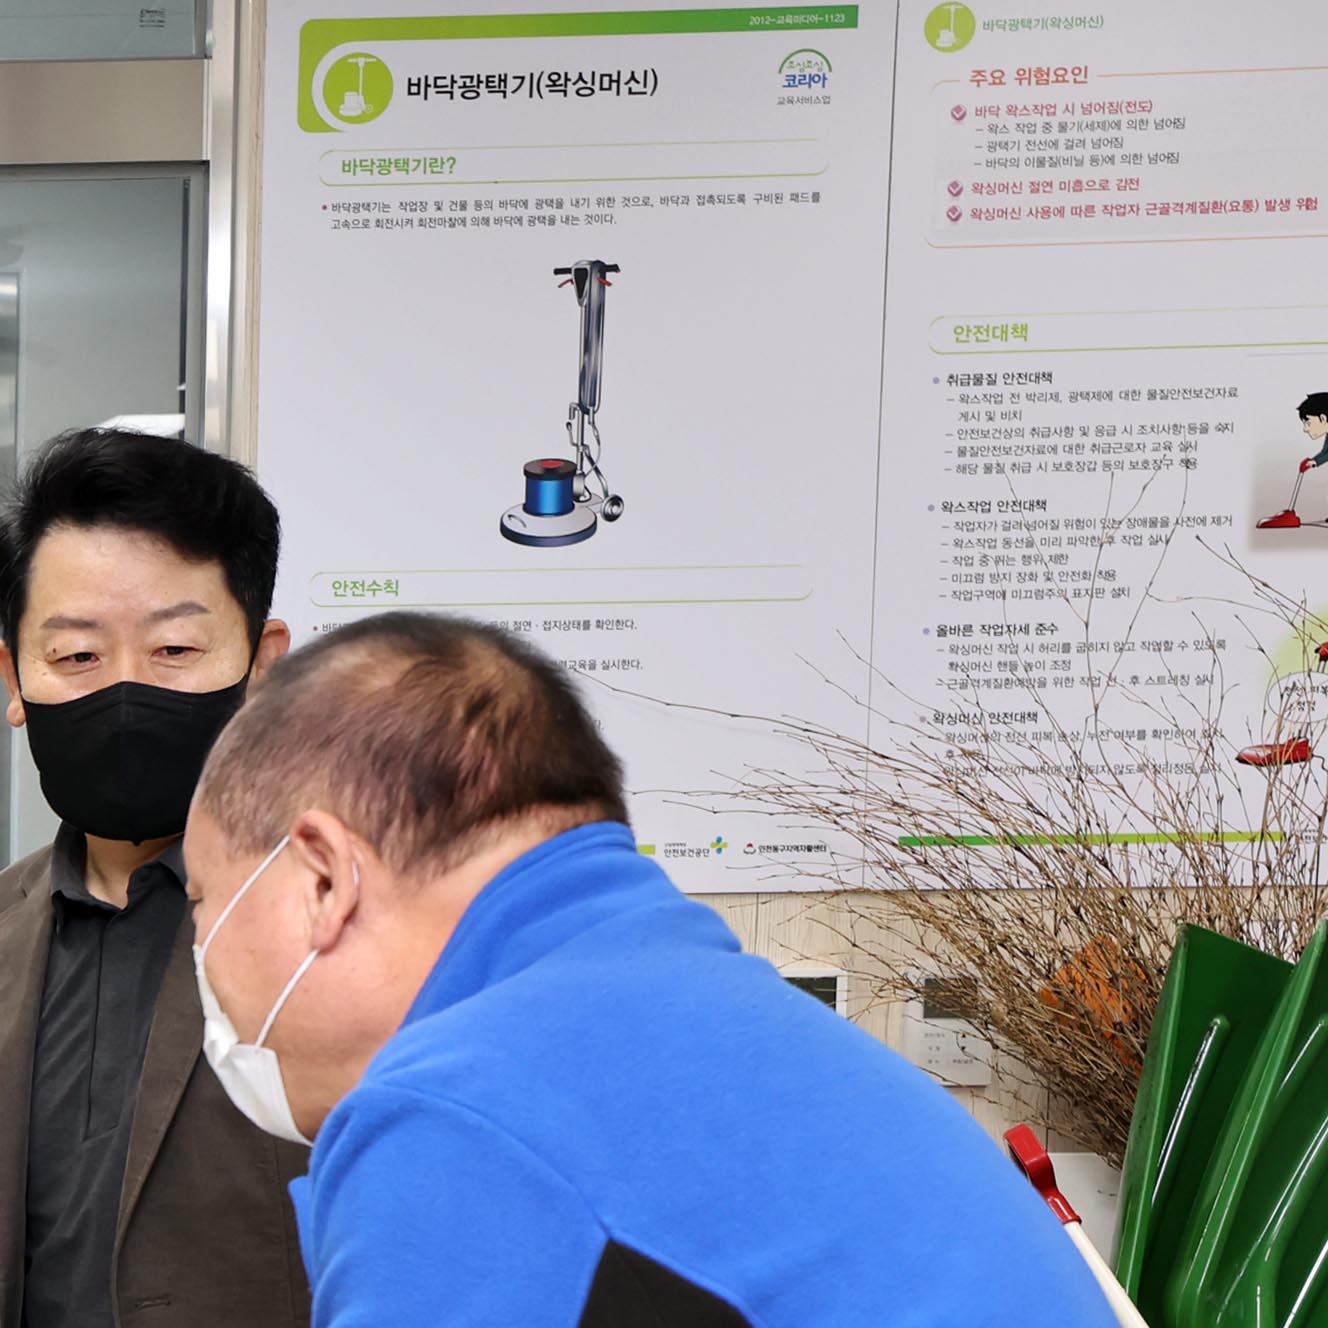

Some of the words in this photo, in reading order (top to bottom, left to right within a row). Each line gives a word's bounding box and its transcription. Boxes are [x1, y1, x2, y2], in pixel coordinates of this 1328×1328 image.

[982, 15, 1104, 32] 바닥광택기(왁싱머신)
[406, 68, 659, 101] 바닥광택기(왁싱머신)
[782, 72, 828, 89] 코리아
[969, 69, 1006, 87] 주요
[1014, 65, 1088, 86] 위험요인
[776, 95, 831, 105] 교육서비스업
[975, 105, 1000, 118] 바닥
[1005, 103, 1056, 118] 왁스작업
[1062, 103, 1074, 116] 시
[1080, 99, 1152, 115] 넘어짐(전도)
[987, 123, 1009, 135] 왁스
[1014, 122, 1036, 134] 작업
[1042, 122, 1052, 134] 중
[1058, 119, 1121, 133] 물기(세제)에
[1126, 118, 1148, 131] 의한
[986, 140, 1020, 152] 광택기
[1025, 139, 1058, 151] 전선에
[1064, 138, 1086, 150] 걸려
[340, 155, 457, 178] 바닥광택기란?
[986, 157, 1020, 169] 바닥의
[1024, 155, 1084, 168] 이물질(비닐
[1089, 154, 1115, 166] 등)에
[1120, 153, 1142, 165] 의한
[970, 181, 1022, 196] 왁싱머신
[1028, 180, 1053, 194] 절연
[1059, 178, 1110, 192] 미흡으로
[1116, 177, 1139, 191] 감전
[332, 201, 390, 214] 바닥광택기는
[398, 200, 428, 213] 작업장
[434, 200, 443, 211] 및
[448, 200, 468, 212] 건물
[473, 199, 493, 211] 등의
[498, 198, 528, 210] 바닥에
[534, 198, 564, 210] 광택을
[570, 197, 590, 208] 내기
[596, 196, 616, 208] 위한
[621, 196, 654, 208] 것으로,
[660, 195, 690, 206] 바닥과
[696, 193, 746, 206] 접촉되도록
[753, 192, 783, 204] 구비된
[790, 192, 820, 203] 패드를
[970, 207, 1021, 221] 왁싱머신
[1026, 205, 1065, 220] 사용에
[1070, 204, 1096, 218] 따른
[1102, 203, 1140, 217] 작업자
[1144, 199, 1259, 216] 근골격계질환(요통)
[1264, 198, 1290, 212] 발생
[331, 219, 370, 230] 고속으로
[374, 217, 413, 229] 회전시켜
[418, 216, 466, 229] 회전마찰에
[470, 216, 490, 227] 의해
[494, 216, 523, 227] 바닥에
[526, 214, 556, 226] 광택을
[560, 214, 580, 226] 내는
[584, 213, 616, 225] 것이다.
[953, 323, 1028, 344] 안전대책
[946, 372, 997, 387] 취급물질
[1002, 371, 1052, 385] 안전대책
[958, 392, 1003, 405] 왁스작업
[1009, 392, 1020, 404] 전
[1026, 391, 1062, 403] 박리제,
[1068, 390, 1112, 403] 광택제에
[1118, 389, 1141, 401] 대한
[1146, 387, 1238, 400] 물질안전보건자료
[958, 410, 980, 422] 게시
[985, 410, 995, 422] 및
[1000, 410, 1022, 422] 비치
[956, 427, 1024, 440] 안전보건상의
[1029, 426, 1074, 438] 취급사항
[1079, 425, 1089, 437] 및
[1094, 424, 1116, 437] 응급
[1121, 424, 1132, 435] 시
[1136, 423, 1185, 437] 조치사항
[1187, 422, 1209, 435] 등을
[956, 444, 1058, 458] 물질안전보건자료에
[1062, 443, 1084, 455] 대한
[1090, 441, 1146, 454] 취급근로자
[1150, 440, 1173, 454] 교육
[956, 463, 978, 475] 해당
[1010, 461, 1032, 473] 취급
[1036, 461, 1047, 472] 시
[1051, 460, 1097, 472] 보호장갑
[1102, 459, 1124, 473] 등의
[1128, 457, 1174, 472] 보호장구
[940, 500, 991, 514] 왁스작업
[996, 498, 1046, 514] 안전대책
[331, 579, 399, 598] 안전수칙
[513, 620, 531, 631] 절연
[542, 619, 591, 632] 접지상태를
[595, 619, 637, 631] 확인한다.
[936, 624, 974, 638] 올바른
[979, 622, 1030, 638] 작업자세
[1034, 622, 1058, 635] 준수
[601, 659, 643, 671] 실시한다.
[664, 848, 710, 858] 안전보건공단
[758, 844, 827, 853] 인천동구지역자활센터
